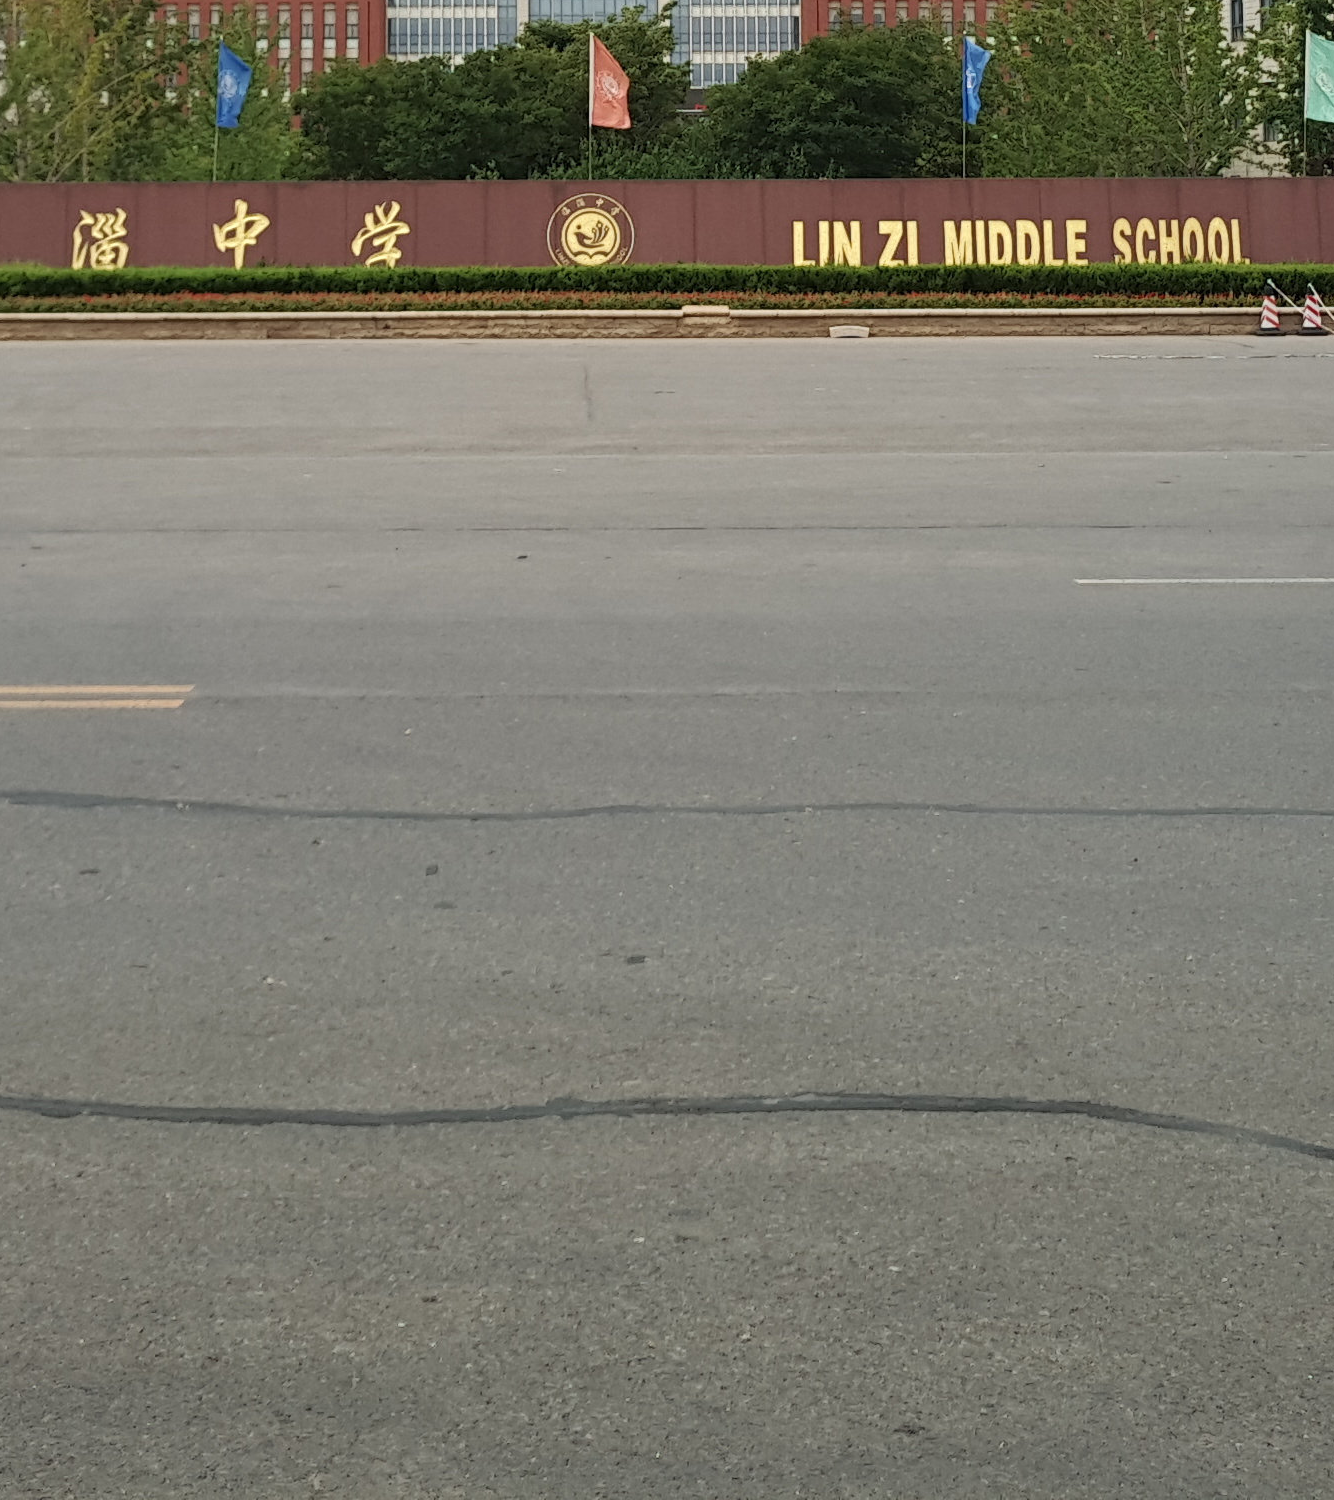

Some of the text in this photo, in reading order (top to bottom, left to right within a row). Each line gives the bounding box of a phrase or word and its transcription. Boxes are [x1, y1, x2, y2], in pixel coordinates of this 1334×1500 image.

[792, 216, 1251, 267] LIN ZI MIDDLE SCHOOL
